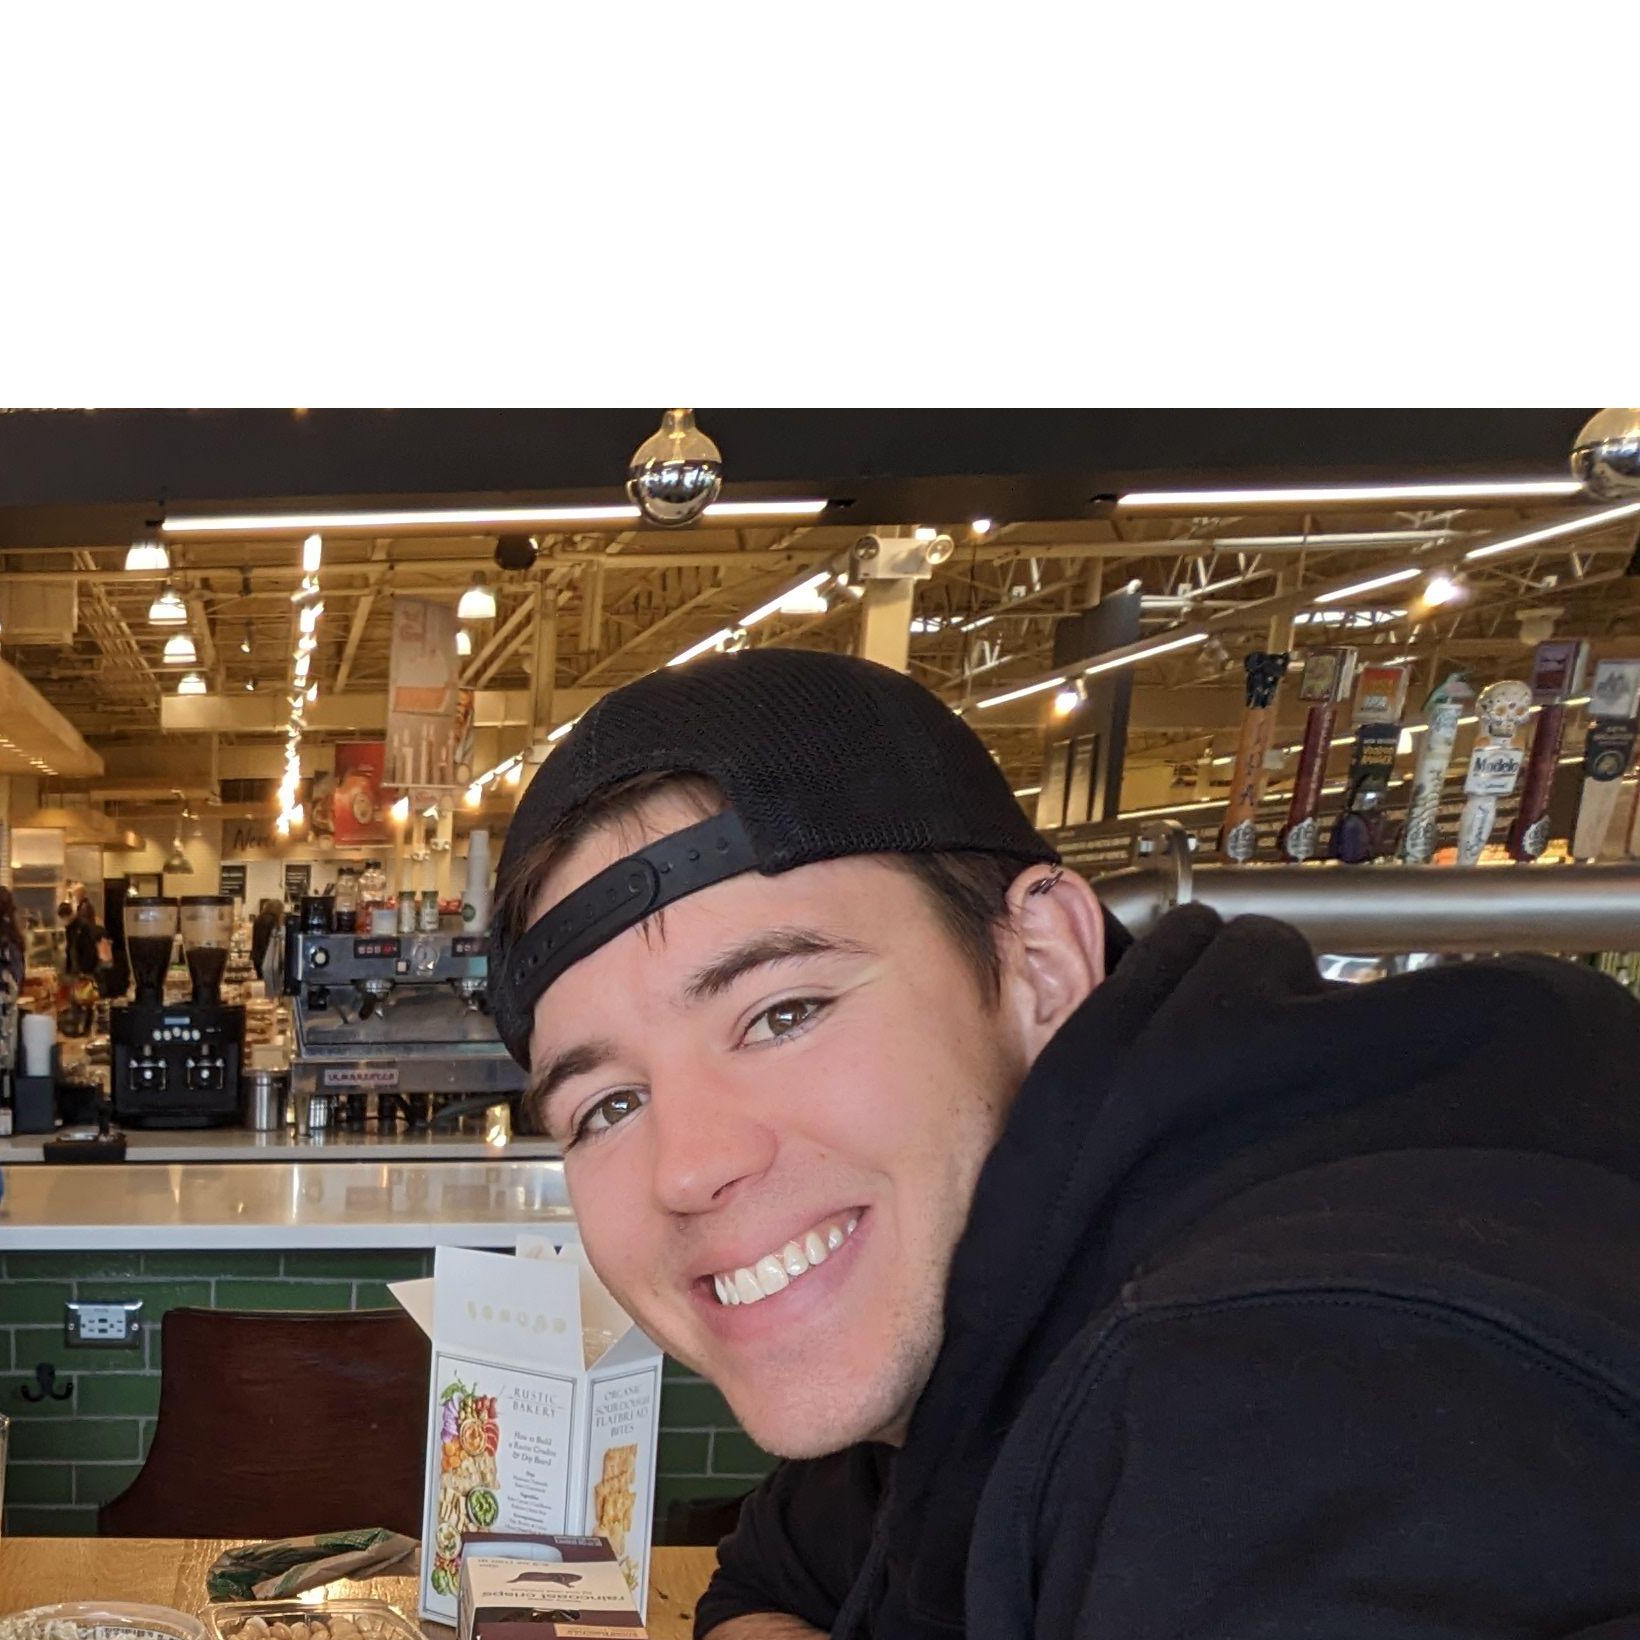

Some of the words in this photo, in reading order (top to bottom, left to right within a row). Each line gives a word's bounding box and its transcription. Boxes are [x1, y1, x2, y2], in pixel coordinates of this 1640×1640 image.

[514, 1387, 557, 1404] RUSTIC
[513, 1402, 557, 1418] BAKERY
[541, 1592, 625, 1602] raincoast
